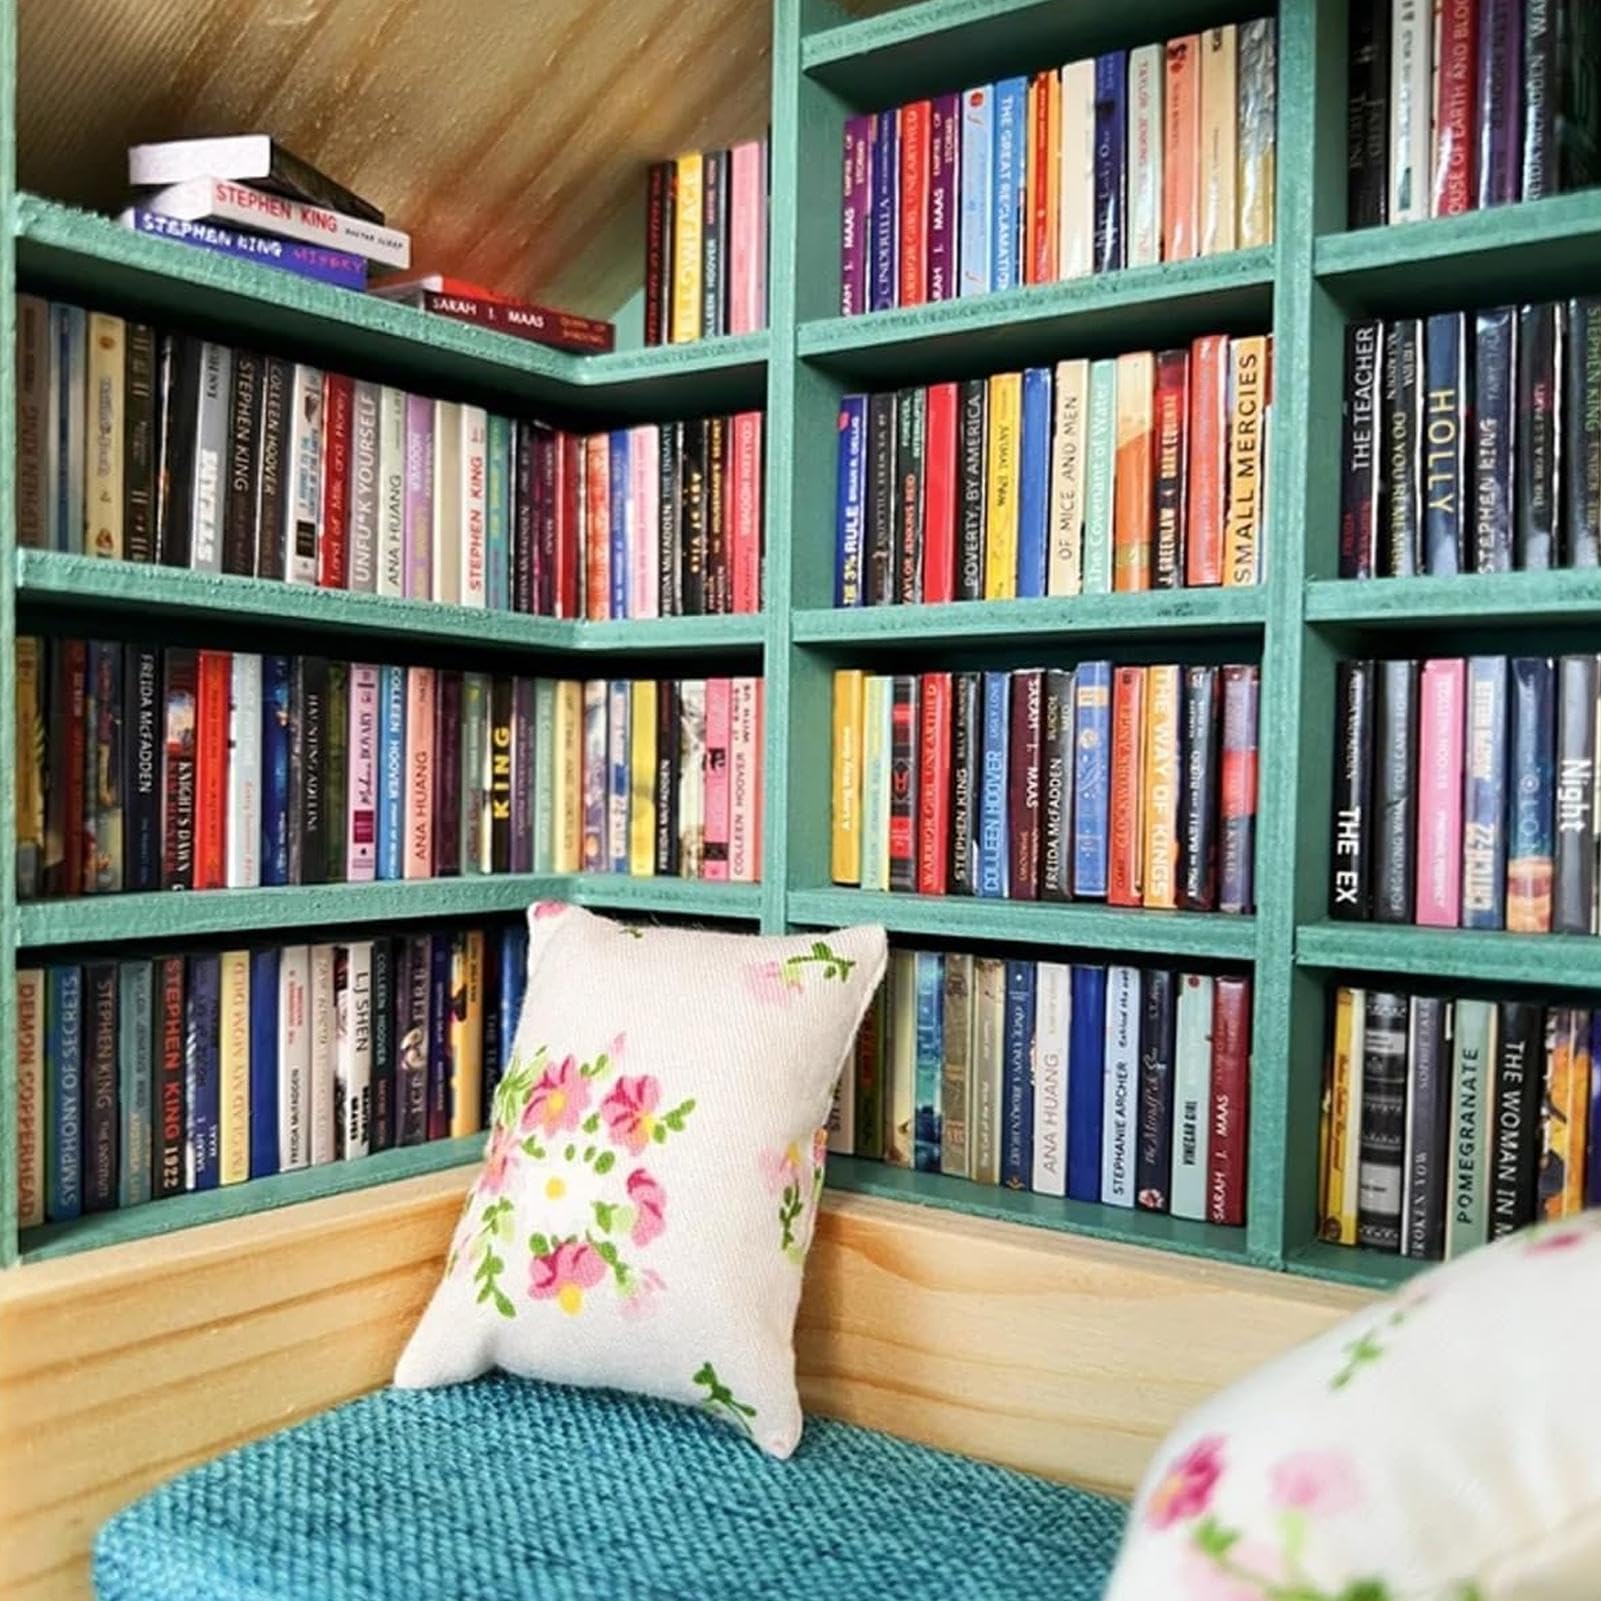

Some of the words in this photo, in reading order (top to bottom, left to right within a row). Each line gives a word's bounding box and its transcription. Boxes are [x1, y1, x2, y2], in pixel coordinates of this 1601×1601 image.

[1002, 95, 1013, 126] THE
[1001, 130, 1012, 179] GREAT
[216, 184, 291, 220] STEPHEN
[300, 209, 337, 233] KING
[933, 188, 944, 230] MAAS
[1449, 173, 1466, 214] OUSE
[143, 214, 231, 248] STEPHEN
[238, 235, 282, 258] KING
[844, 208, 855, 248] MAAS
[432, 298, 477, 316] SARAH
[508, 310, 545, 329] MAAS
[236, 360, 255, 442] STEPHEN
[267, 366, 284, 430] COLLEEN
[1354, 327, 1373, 426] TEACHER
[336, 389, 348, 438] Honey
[967, 395, 981, 474] AMERICA
[1064, 396, 1077, 436] MEN
[1237, 354, 1257, 479] MERCIES
[234, 444, 251, 491] KING
[263, 433, 279, 496] HOOVER
[335, 445, 344, 473] and
[358, 393, 377, 496] YOURSELF
[1063, 443, 1076, 480] AND
[1353, 430, 1372, 471] THE
[1428, 388, 1455, 513] HOLLY
[1480, 418, 1497, 470] KING
[471, 456, 483, 499] KING
[966, 478, 980, 501] BY
[333, 518, 343, 536] of
[389, 475, 402, 542] HUANG
[845, 506, 859, 554] RULE
[1061, 491, 1074, 531] MICE
[1478, 477, 1495, 575] STEPHEN
[330, 541, 342, 582] Land
[470, 509, 482, 591] STEPHEN
[965, 505, 981, 586] POVERTY,
[1060, 540, 1072, 561] OF
[1234, 488, 1255, 584] SMALL
[388, 547, 401, 586] ANA
[140, 655, 154, 706] FREIDA
[391, 667, 401, 733] COLLEEN
[1154, 669, 1168, 714] THE
[138, 711, 153, 792] McFADDEN
[389, 739, 400, 799] HOOVER
[494, 726, 510, 819] KING
[1153, 726, 1169, 774] WAY
[415, 751, 427, 817] HUANG
[735, 752, 746, 807] HOOVER
[956, 768, 968, 806] KING
[985, 751, 1001, 813] HOOVER
[1026, 766, 1039, 808] MAAS
[1047, 758, 1062, 836] McFADDEN
[1152, 785, 1167, 815] OF
[1557, 758, 1593, 833] Night
[177, 829, 191, 872] DAWN
[414, 823, 427, 861] ANA
[733, 814, 744, 876] COLLEEN
[955, 810, 967, 881] STEPHEN
[984, 817, 1000, 891] COLLEEN
[1338, 806, 1361, 856] THE
[1046, 840, 1059, 890] FREIDA
[1152, 823, 1169, 897] KINGS
[1335, 870, 1358, 904] EX
[18, 983, 35, 1065] DEMON
[63, 975, 78, 1059] SECRETS
[97, 981, 113, 1058] STEPHEN
[164, 958, 183, 1070] STEPHEN
[355, 1000, 369, 1053] SHEN
[63, 1066, 78, 1090] OF
[96, 1062, 113, 1109] KING
[1504, 1040, 1525, 1083] THE
[164, 1081, 181, 1141] KING
[1044, 1054, 1058, 1126] HUANG
[1114, 1061, 1127, 1118] ARCHER
[1216, 1094, 1229, 1137] MAAS
[1457, 1047, 1479, 1224] POMEGRANATE
[1498, 1089, 1522, 1181] WOMAN
[18, 1069, 35, 1216] COPPERHEAD
[61, 1096, 78, 1206] SYMPHONY
[164, 1146, 180, 1189] 1922
[1043, 1132, 1057, 1175] ANA
[1113, 1120, 1126, 1196] STEPHANIE
[1213, 1171, 1227, 1221] SARAH
[1496, 1188, 1517, 1215] IN
